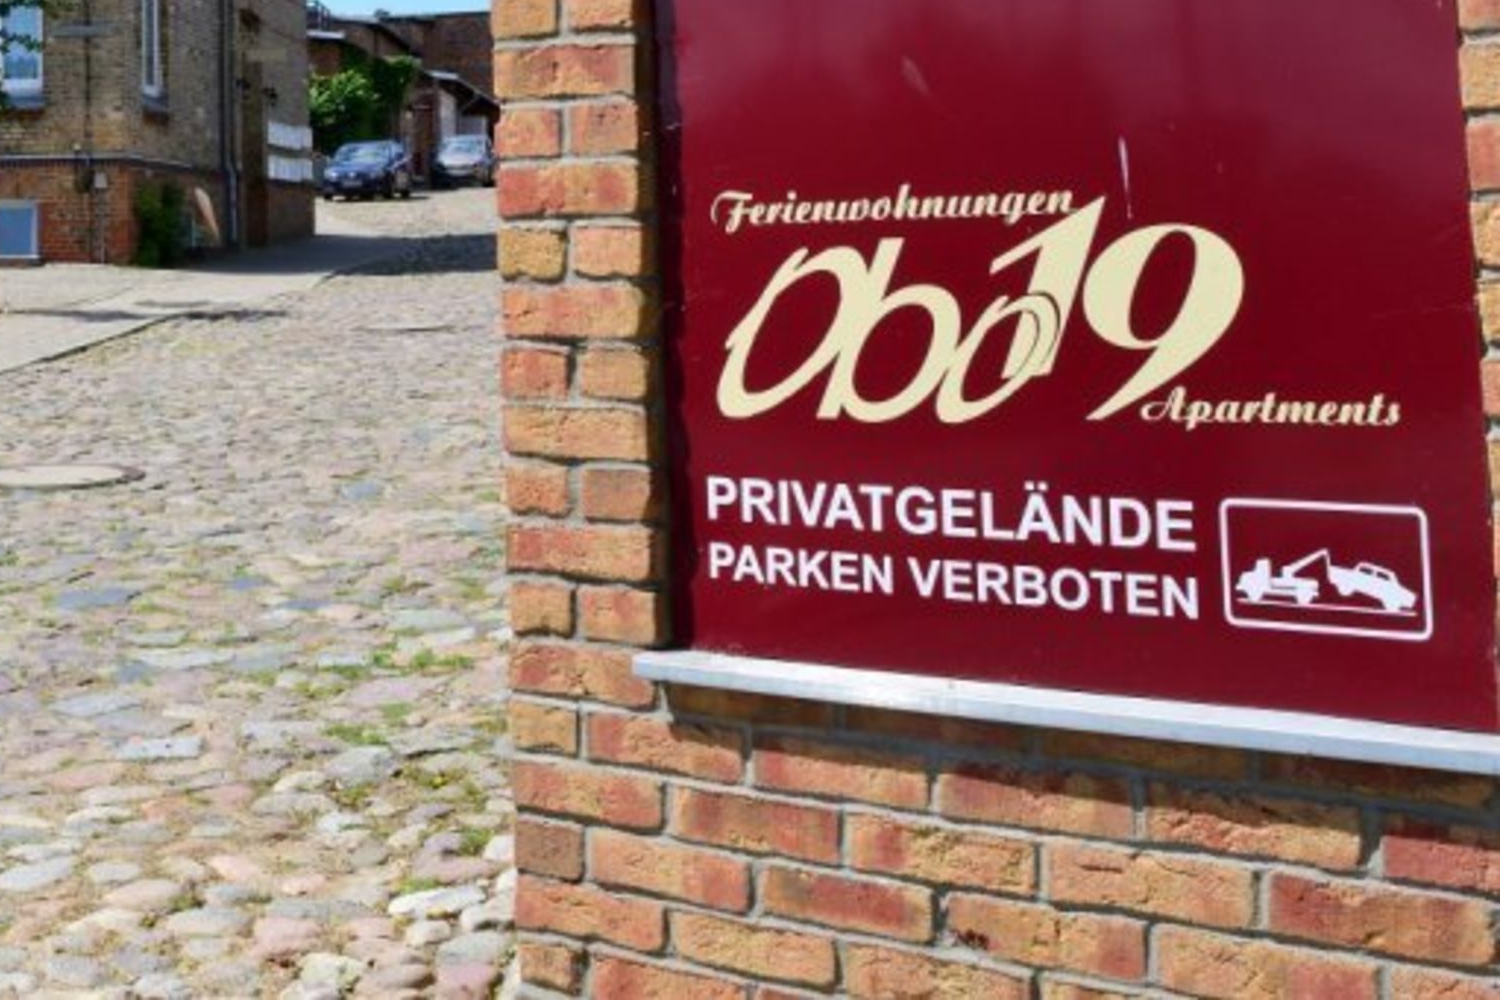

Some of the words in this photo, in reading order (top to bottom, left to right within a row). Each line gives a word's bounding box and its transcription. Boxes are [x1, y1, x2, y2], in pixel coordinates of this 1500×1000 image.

[711, 183, 1075, 233] Ferienwohnungen
[1141, 386, 1400, 431] Apartments
[706, 475, 1197, 552] PRIVATGELÄNDE
[708, 541, 894, 595] PARKEN
[907, 556, 1199, 620] VERBOTEN
